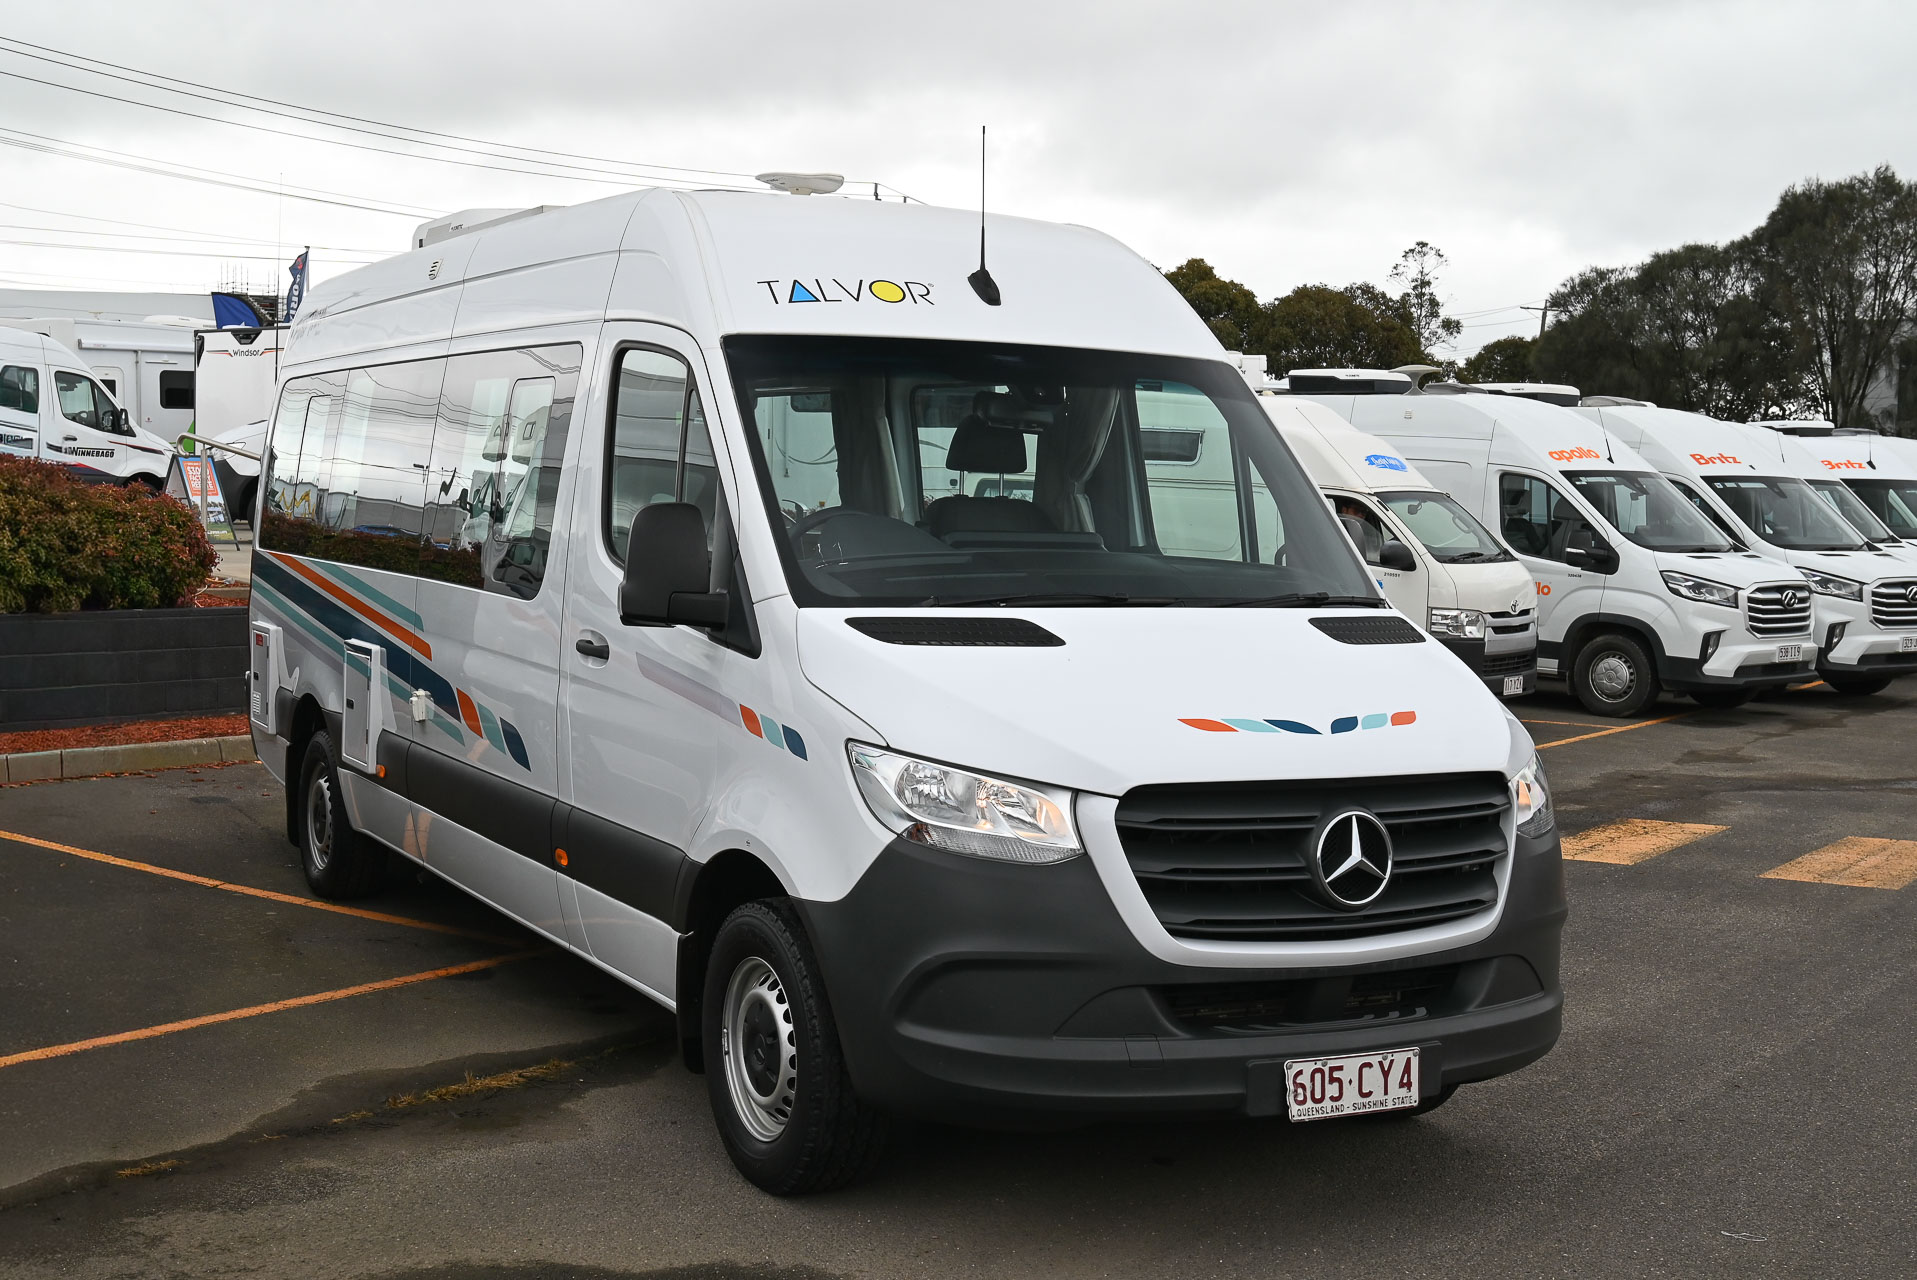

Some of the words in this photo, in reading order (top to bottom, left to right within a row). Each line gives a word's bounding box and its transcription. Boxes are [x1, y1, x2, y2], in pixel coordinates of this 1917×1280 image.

[757, 279, 935, 305] TALVOR
[233, 349, 260, 357] Windsor
[1548, 446, 1600, 462] apollo
[1689, 453, 1742, 465] Britz
[1821, 459, 1866, 470] Britz
[1297, 1104, 1345, 1117] QUEENSLAND
[1352, 1099, 1388, 1111] SUNSHINE
[1392, 1096, 1413, 1106] STATE
